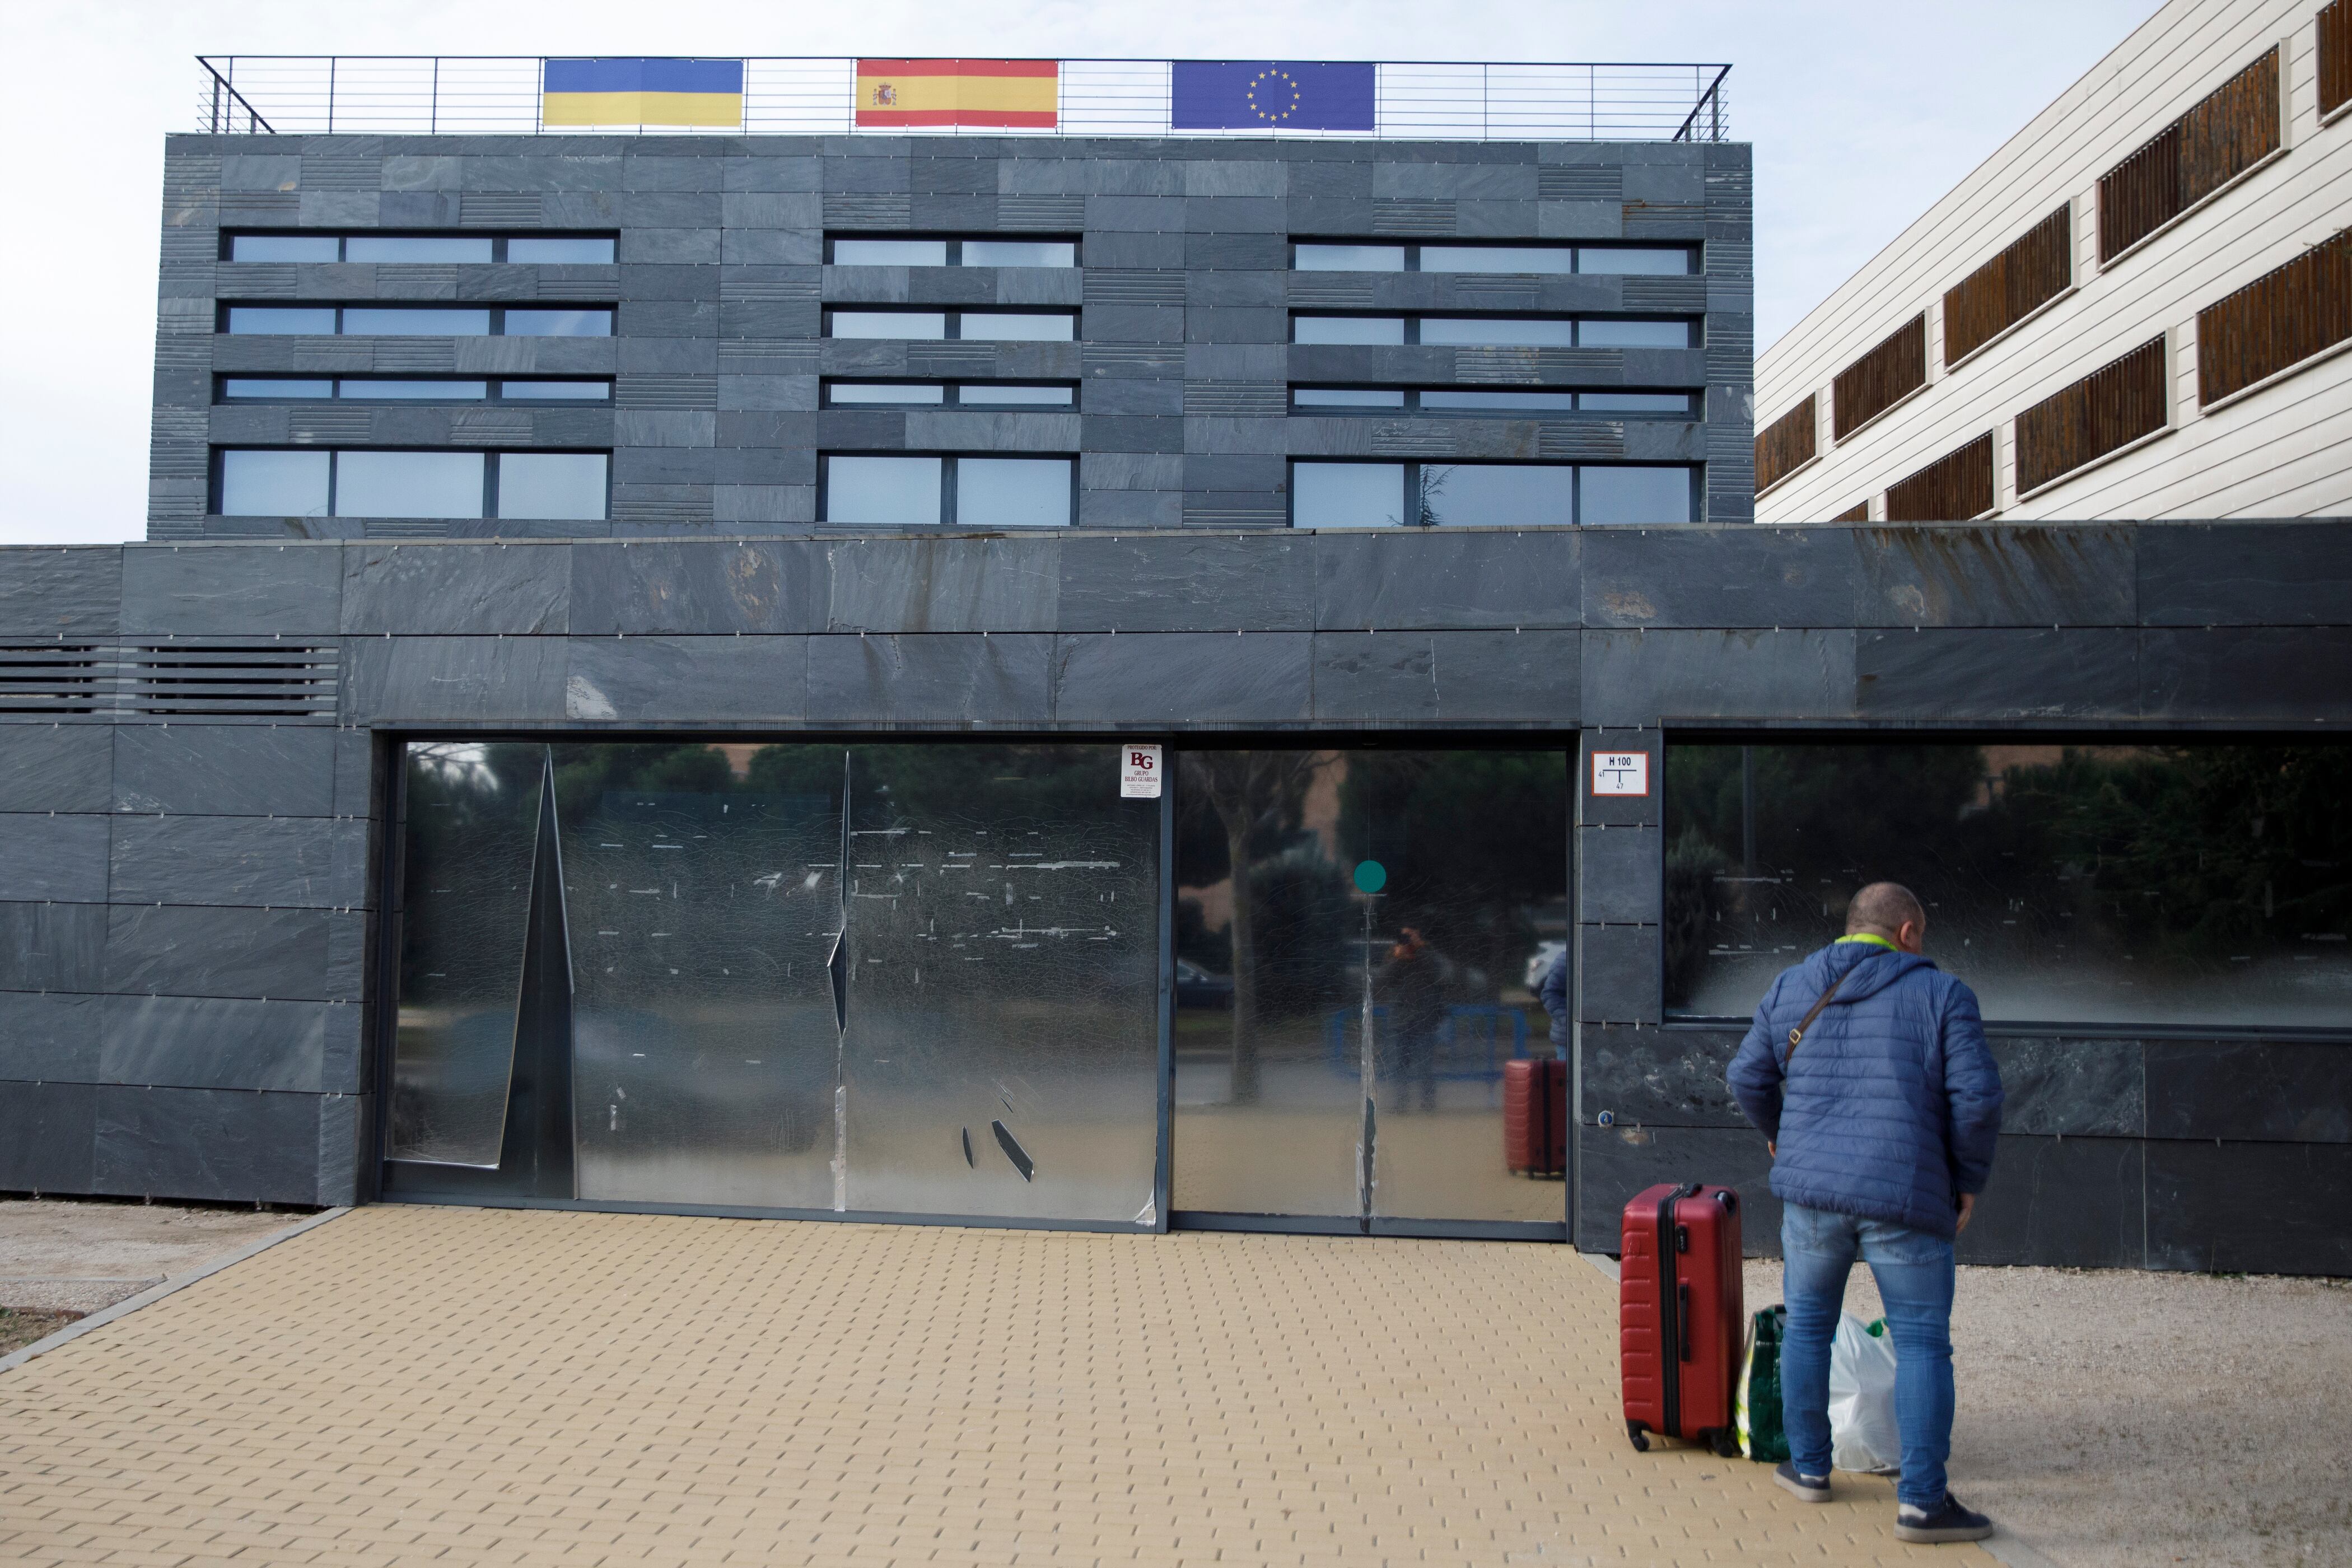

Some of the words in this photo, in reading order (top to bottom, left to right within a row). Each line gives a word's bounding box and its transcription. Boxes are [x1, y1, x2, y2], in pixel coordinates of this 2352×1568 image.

[1131, 752, 1153, 769] BG
[1609, 757, 1614, 766] H
[1618, 757, 1631, 766] 100
